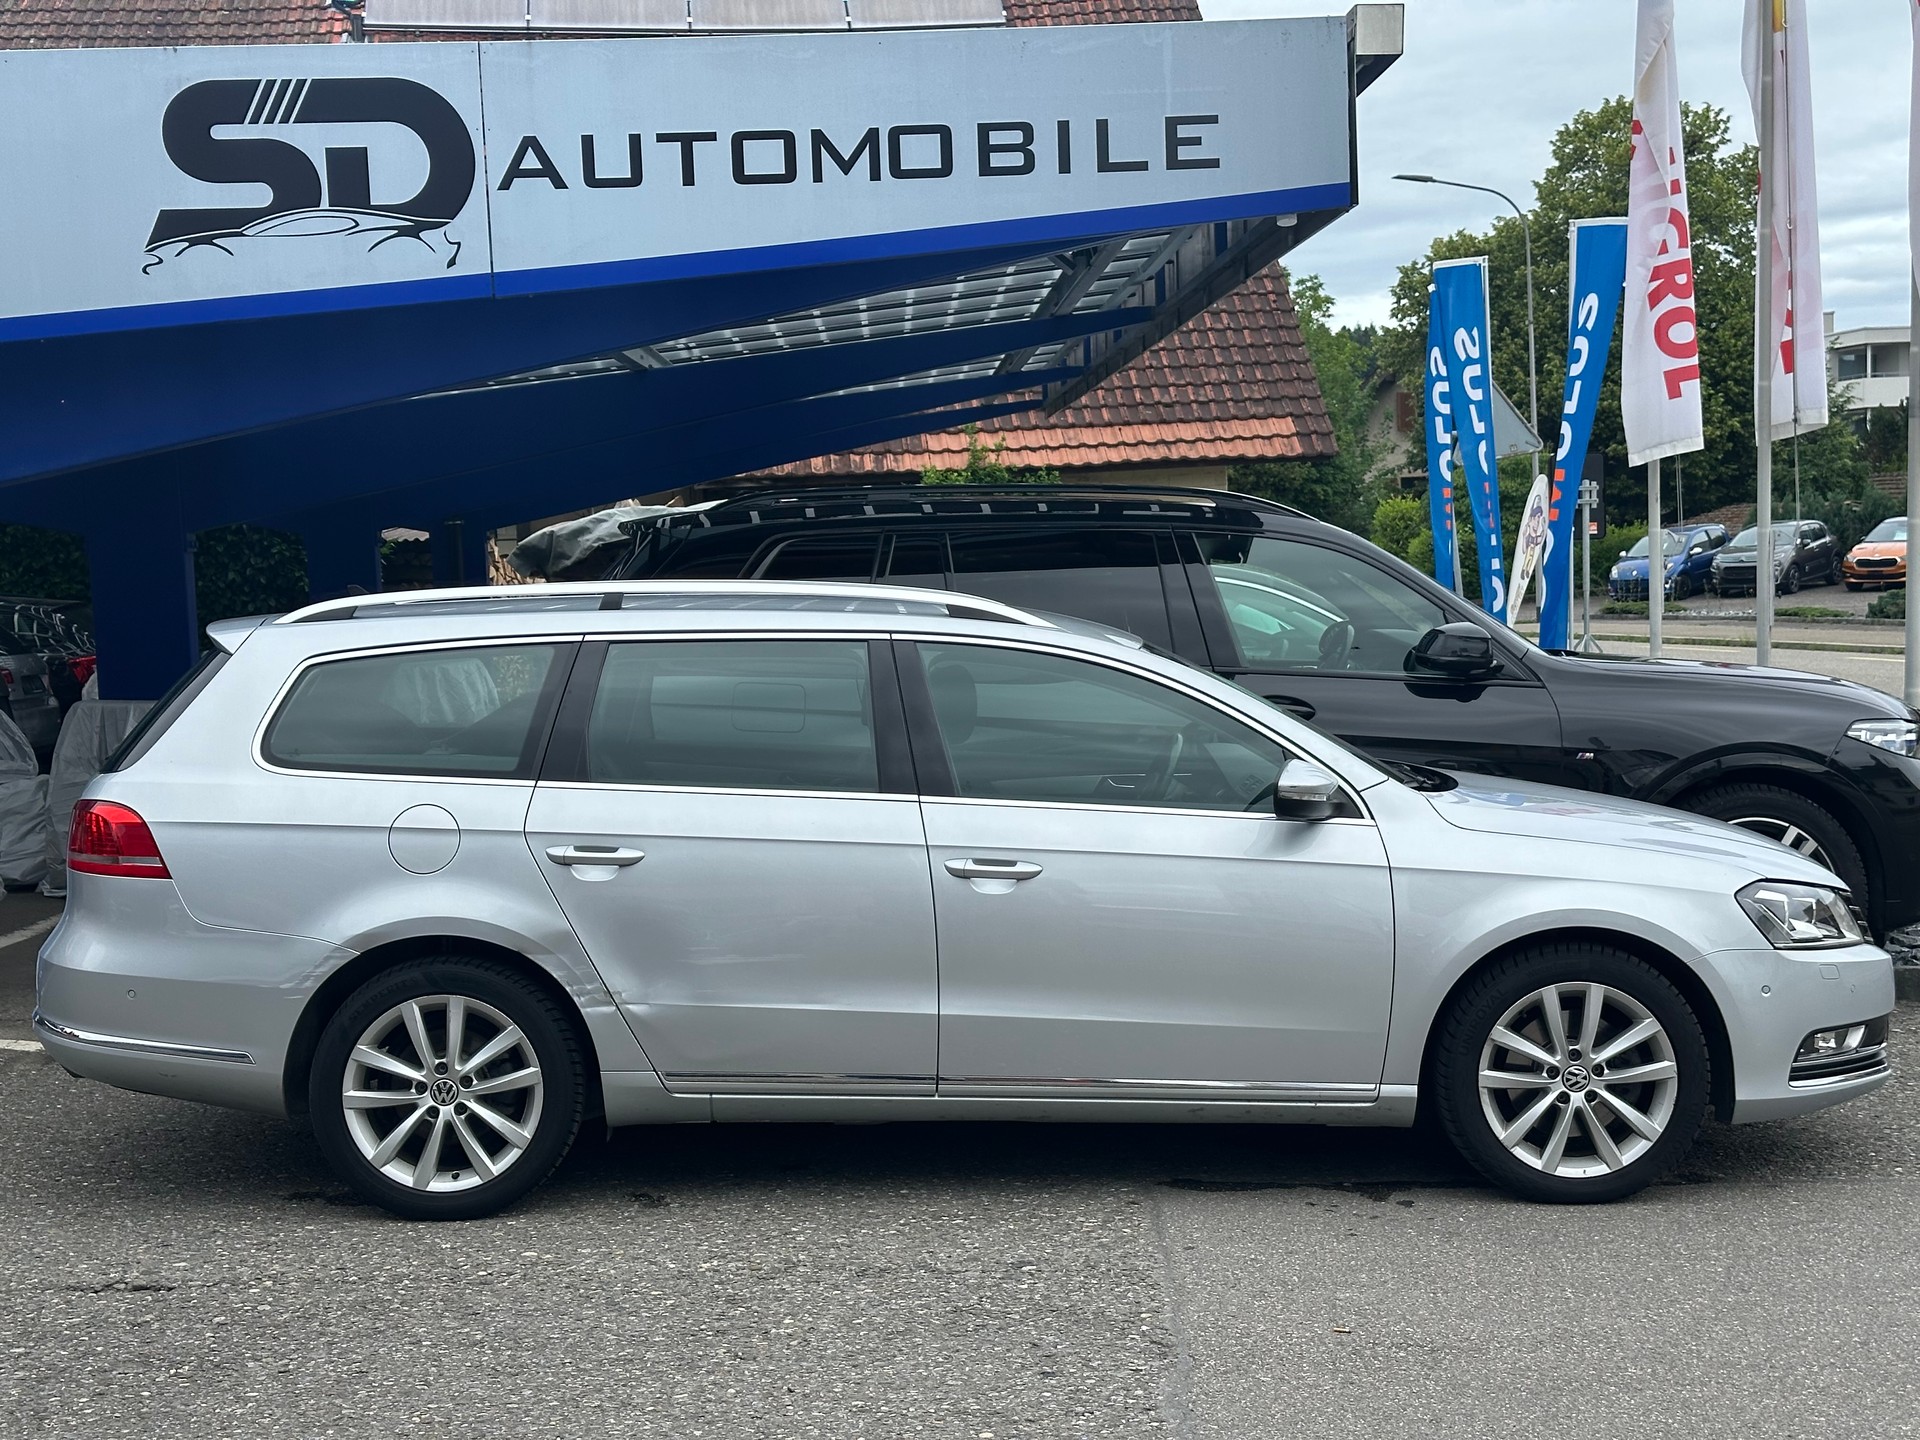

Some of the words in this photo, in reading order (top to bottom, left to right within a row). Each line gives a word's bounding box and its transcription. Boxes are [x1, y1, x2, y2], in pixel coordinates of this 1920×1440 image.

[145, 77, 475, 253] SD
[497, 114, 1221, 190] AUTOMOBILE
[1648, 146, 1701, 401] GROL
[1458, 987, 1509, 1056] UNIROYAL
